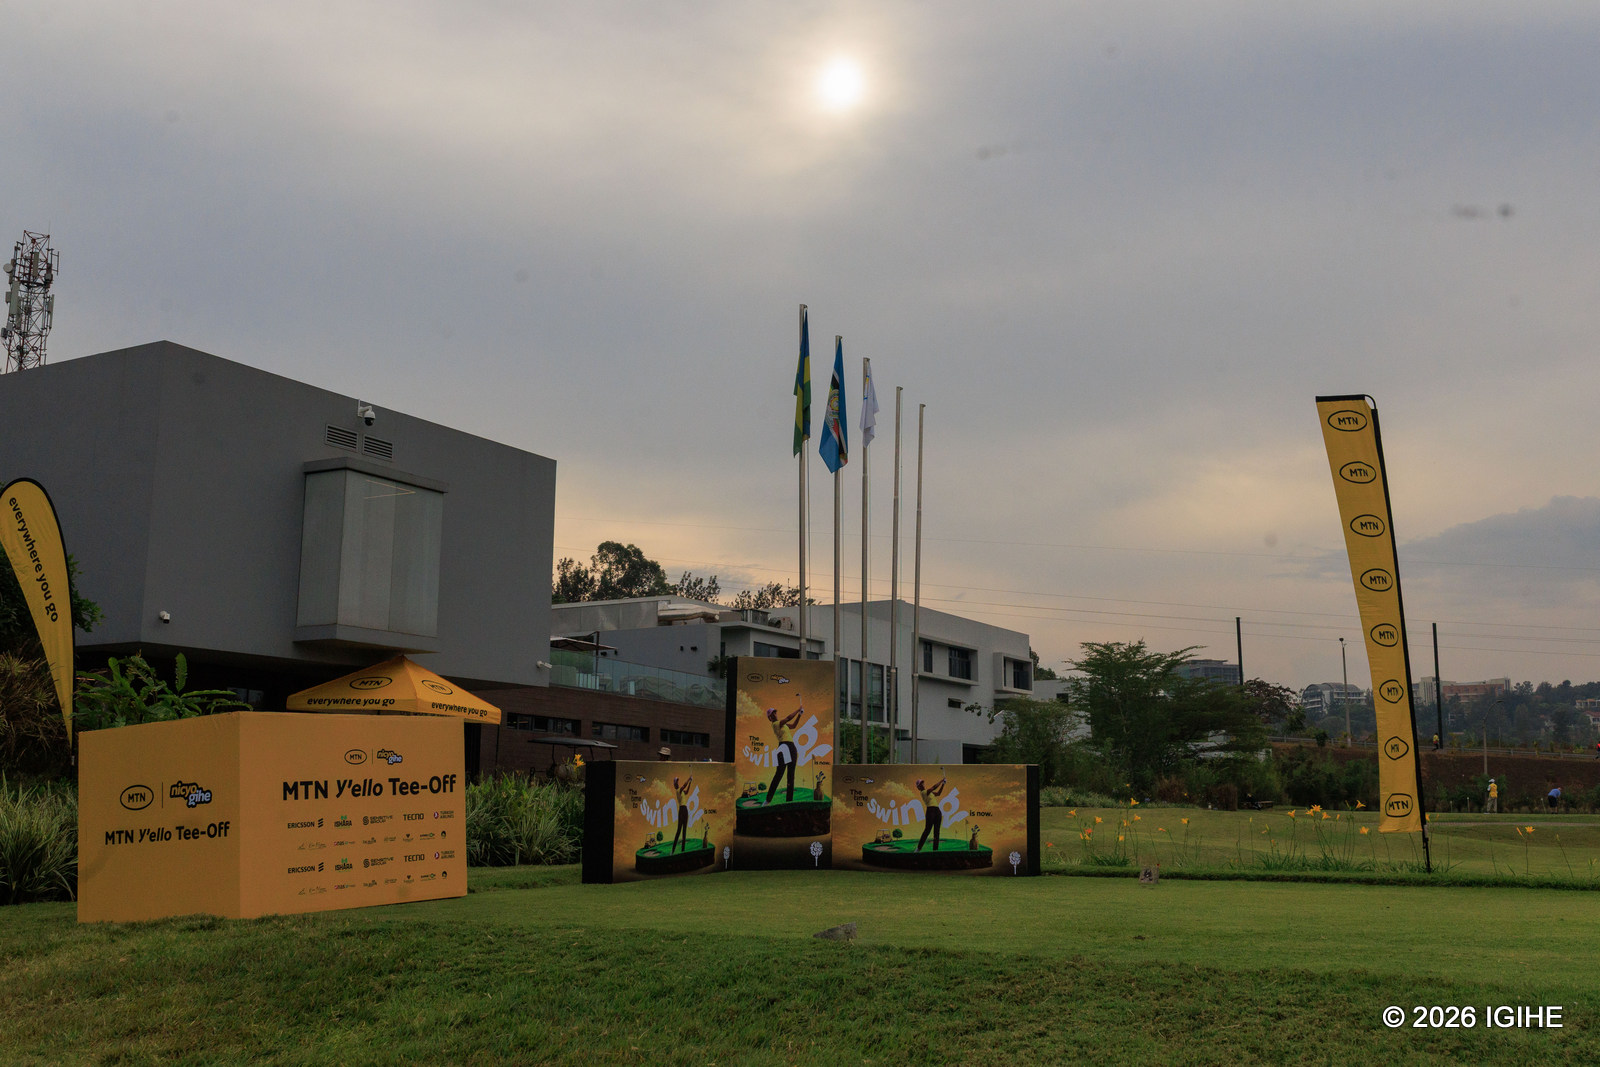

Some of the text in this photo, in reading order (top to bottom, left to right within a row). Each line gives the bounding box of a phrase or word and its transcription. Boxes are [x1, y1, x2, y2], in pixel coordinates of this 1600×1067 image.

[1338, 417, 1358, 425] MTN
[1350, 468, 1368, 477] MTN
[1360, 522, 1379, 530] MTN
[9, 497, 58, 622] everywhere you go
[1369, 576, 1387, 584] MTN
[1379, 631, 1394, 640] MTN
[307, 698, 395, 706] everywhere you go
[432, 702, 488, 717] everywhere you go
[742, 714, 833, 768] swing
[170, 781, 198, 799] nicyo
[283, 780, 328, 800] MTN
[388, 774, 457, 796] Tee-Off
[128, 792, 146, 803] MTN
[187, 788, 212, 808] gihe
[640, 785, 705, 828] swing
[867, 787, 969, 829] swing
[1389, 800, 1408, 811] MTN
[403, 813, 424, 821] TECNO
[288, 821, 315, 829] ERICSSON
[105, 829, 134, 845] MTN
[176, 821, 230, 840] Tee-Off
[404, 854, 425, 862] TECNO
[288, 866, 315, 874] ERICSSON
